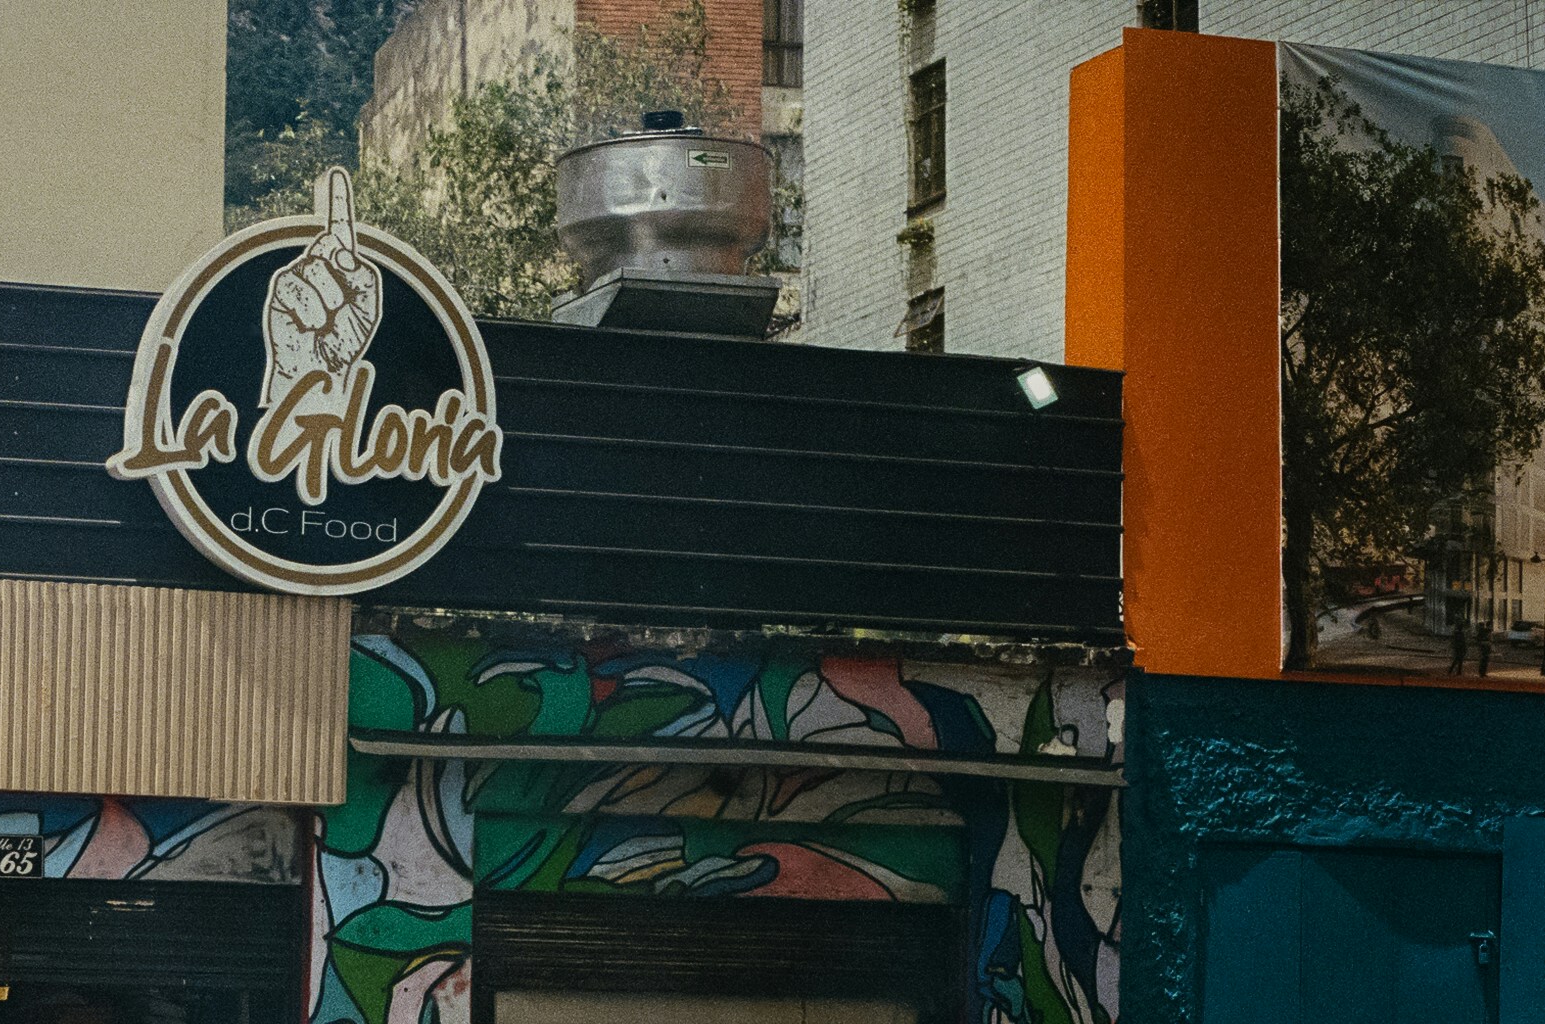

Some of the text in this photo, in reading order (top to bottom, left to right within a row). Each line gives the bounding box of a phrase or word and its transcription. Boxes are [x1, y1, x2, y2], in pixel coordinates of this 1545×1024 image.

[120, 340, 496, 499] La Gloria
[300, 509, 398, 543] Food
[17, 838, 34, 851] 13
